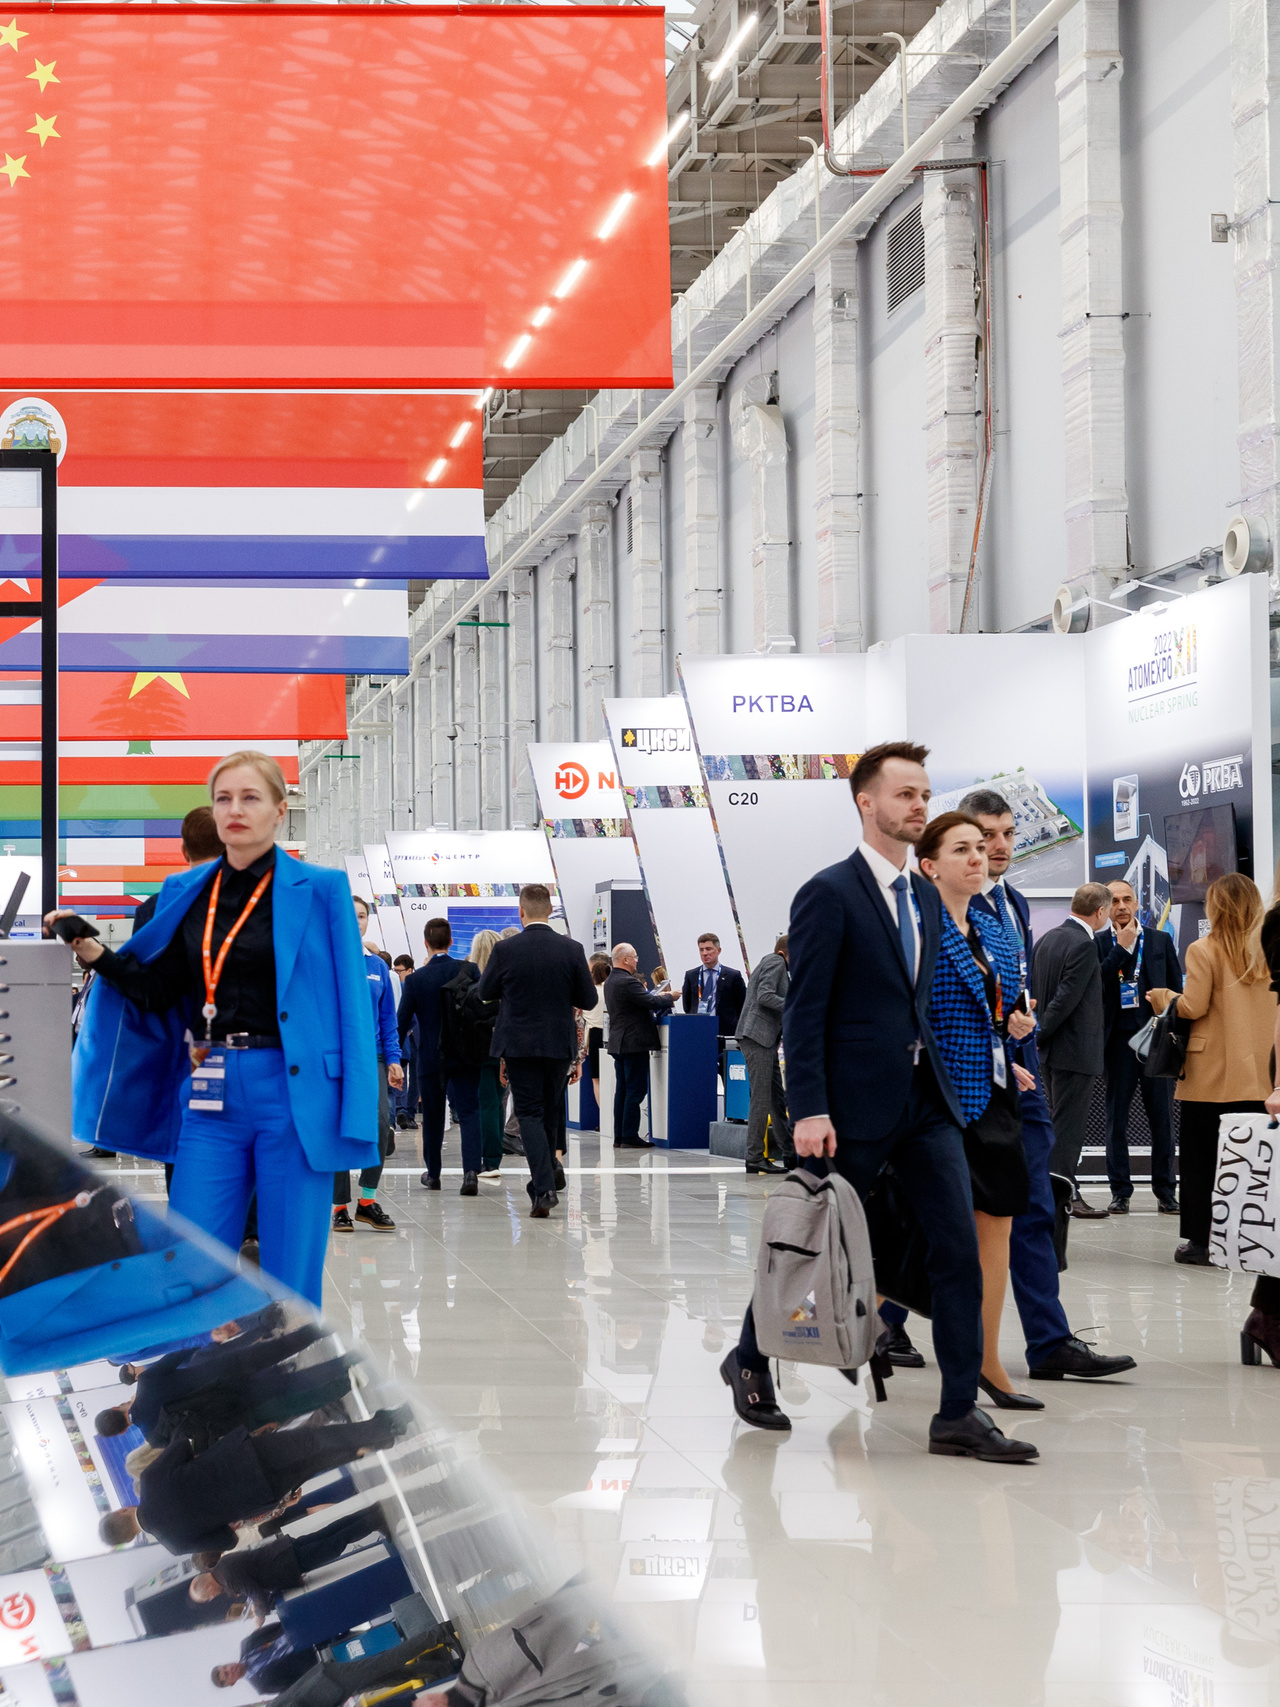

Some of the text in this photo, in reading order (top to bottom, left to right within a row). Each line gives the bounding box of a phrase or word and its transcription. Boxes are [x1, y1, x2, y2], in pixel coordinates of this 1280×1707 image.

[1154, 631, 1172, 656] 2022
[1128, 655, 1173, 692] ATOMEXPO
[733, 695, 813, 712] PKTBA
[1128, 691, 1198, 724] NUCLEAR SPRING
[636, 728, 691, 754] ЦКСИ
[728, 792, 758, 805] C20
[411, 903, 427, 911] C40
